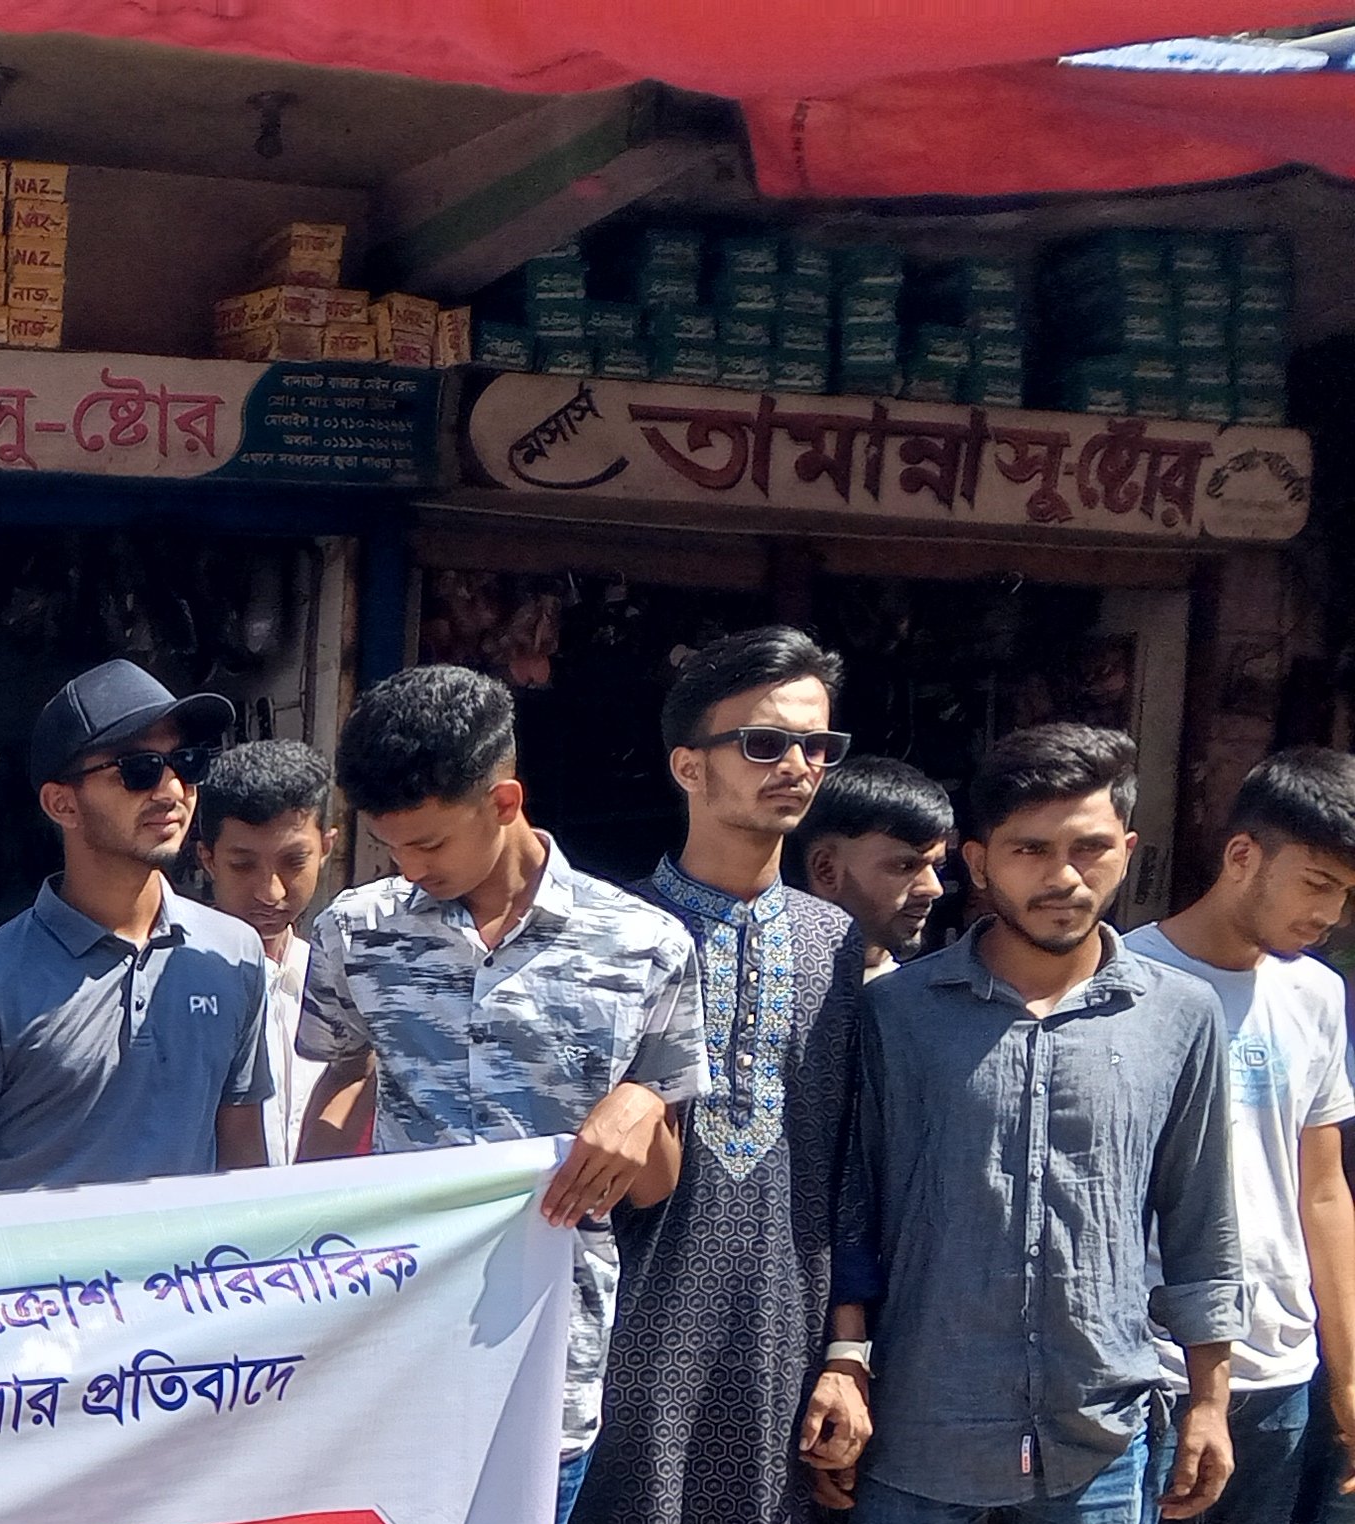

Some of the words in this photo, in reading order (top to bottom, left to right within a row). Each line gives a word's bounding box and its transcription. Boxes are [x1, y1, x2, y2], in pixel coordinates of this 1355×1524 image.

[14, 178, 50, 194] NAZ
[17, 250, 49, 266] NAZ
[629, 397, 989, 510] তামান্না
[144, 1233, 421, 1316] পারিবারিক
[81, 1348, 307, 1427] প্রতিবাদে
